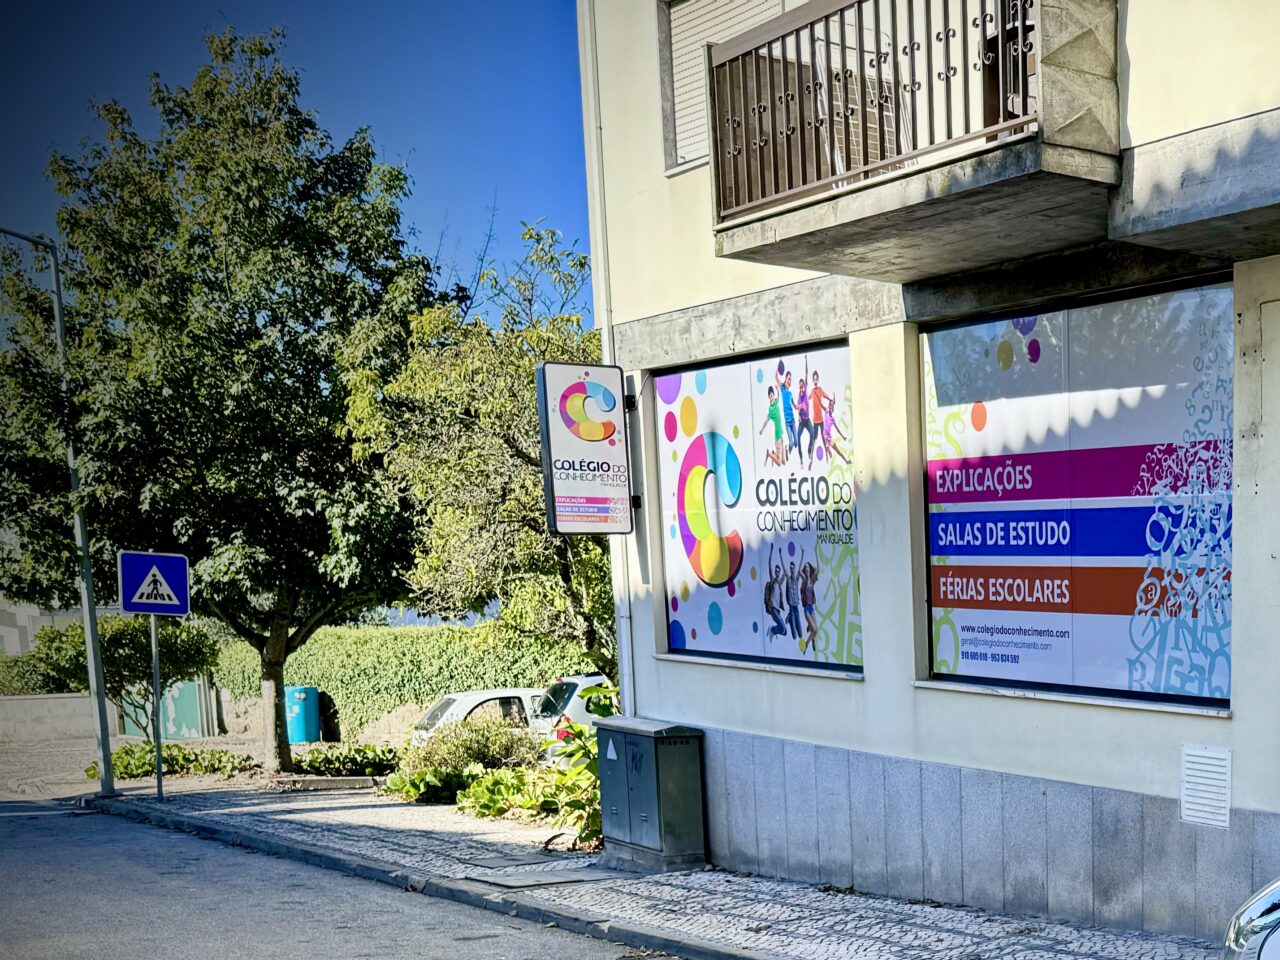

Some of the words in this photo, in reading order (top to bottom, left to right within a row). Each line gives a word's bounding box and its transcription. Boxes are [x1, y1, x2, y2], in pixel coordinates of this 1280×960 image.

[554, 458, 611, 472] COLÉGIO
[612, 464, 627, 473] DO
[755, 472, 830, 507] COLÉGIO
[832, 482, 852, 504] DO
[936, 460, 1033, 497] EXPLICAÇÕES
[757, 508, 853, 532] CONHECIMENTO
[817, 533, 854, 544] MANGUALDE
[938, 522, 982, 546] SALAS
[986, 522, 1005, 545] DE
[1009, 521, 1071, 545] ESTUDO
[940, 571, 985, 601] FÉRIAS
[989, 578, 1070, 604] ESCOLARES
[961, 624, 1070, 639] www.colegiodoconhecimento.com
